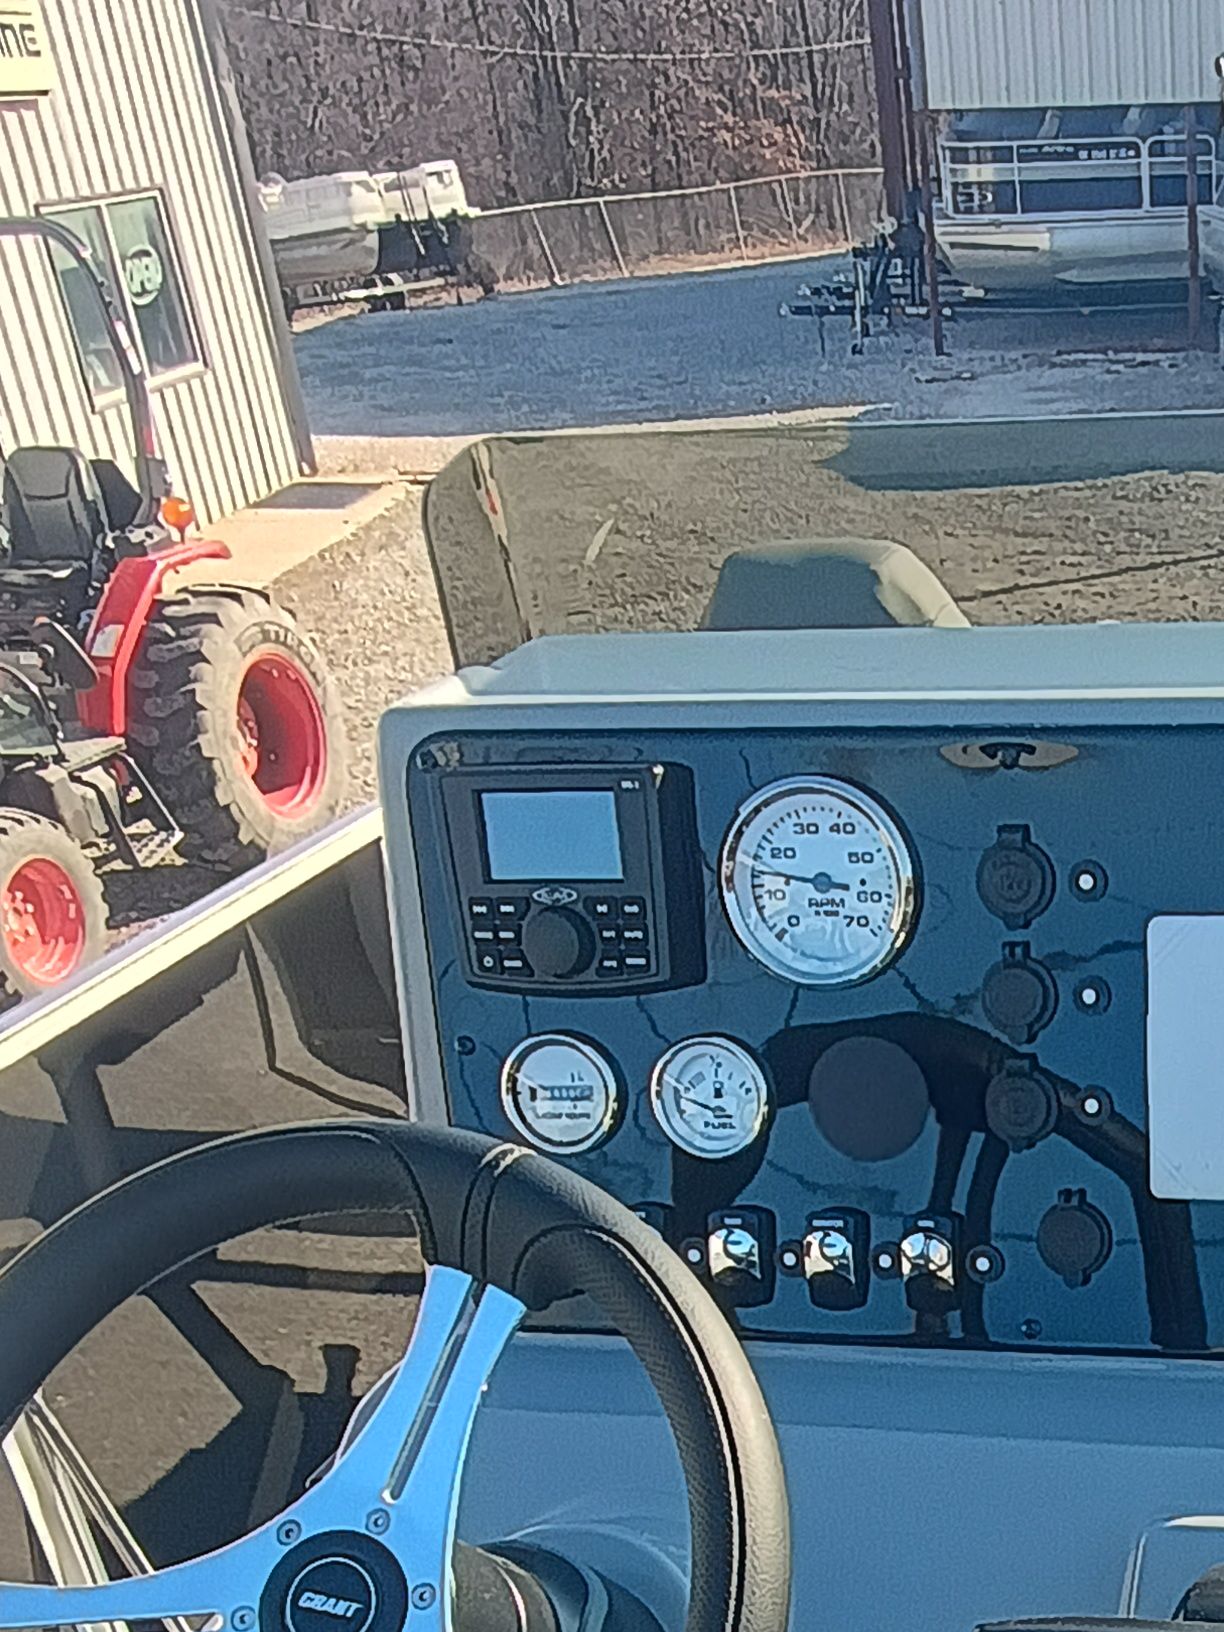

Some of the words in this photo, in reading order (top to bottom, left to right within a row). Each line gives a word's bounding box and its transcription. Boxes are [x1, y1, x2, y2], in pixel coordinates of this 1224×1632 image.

[793, 823, 819, 835] 30
[829, 823, 856, 835] 40
[770, 847, 796, 859] 20
[847, 852, 874, 864] 50
[764, 889, 786, 900] 10
[857, 891, 882, 903] 60
[808, 898, 845, 909] RPM
[787, 915, 800, 927] 0
[843, 915, 870, 928] 70
